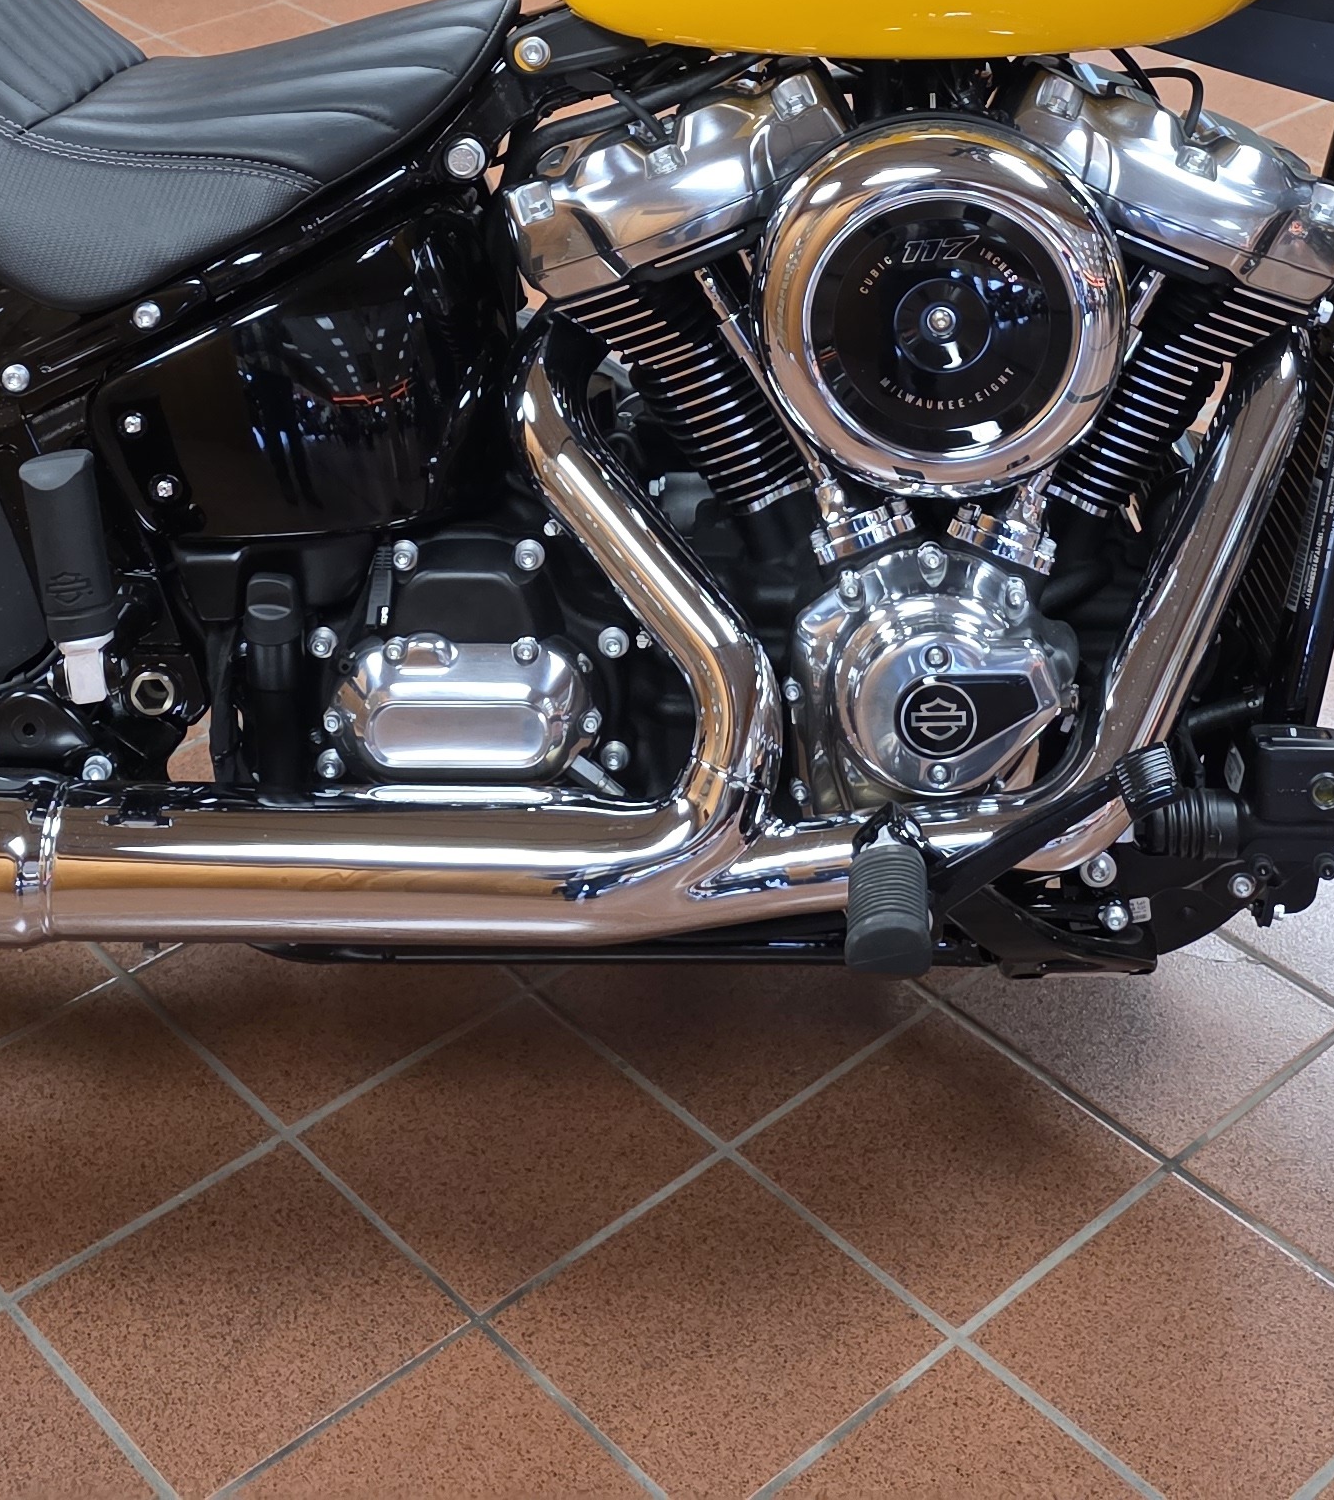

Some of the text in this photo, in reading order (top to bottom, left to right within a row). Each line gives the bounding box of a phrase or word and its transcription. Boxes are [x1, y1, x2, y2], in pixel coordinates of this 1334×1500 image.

[860, 234, 1018, 295] CUBIC 117 INCHES
[879, 366, 1016, 410] MILWAUKEE-EIGHT
